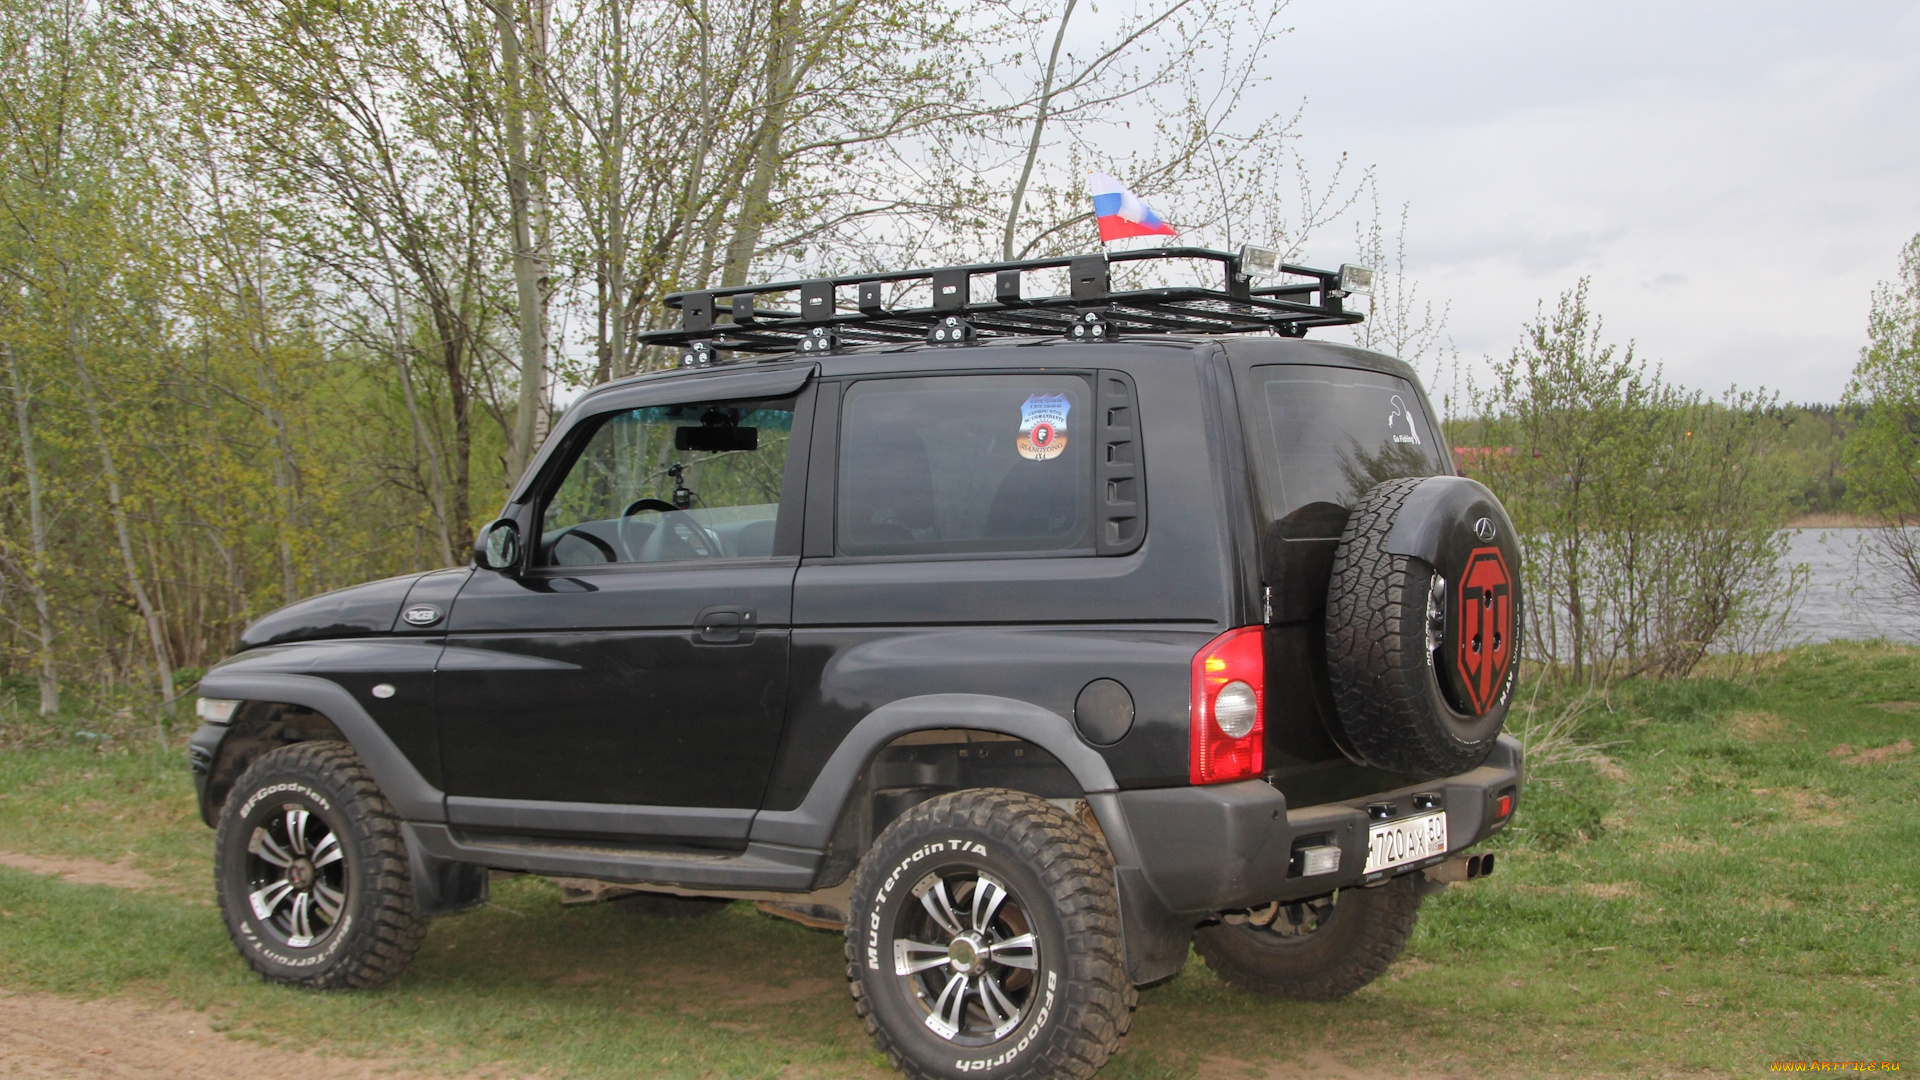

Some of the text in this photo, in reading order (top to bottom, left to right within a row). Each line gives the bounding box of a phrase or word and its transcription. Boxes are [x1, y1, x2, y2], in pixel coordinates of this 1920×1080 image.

[1019, 443, 1063, 453] SSANGYONG
[407, 610, 435, 620] TAGER
[1427, 817, 1442, 842] 50
[868, 839, 987, 970] Mud-Terrain T/A
[956, 970, 1058, 1072] BFGoodrich
